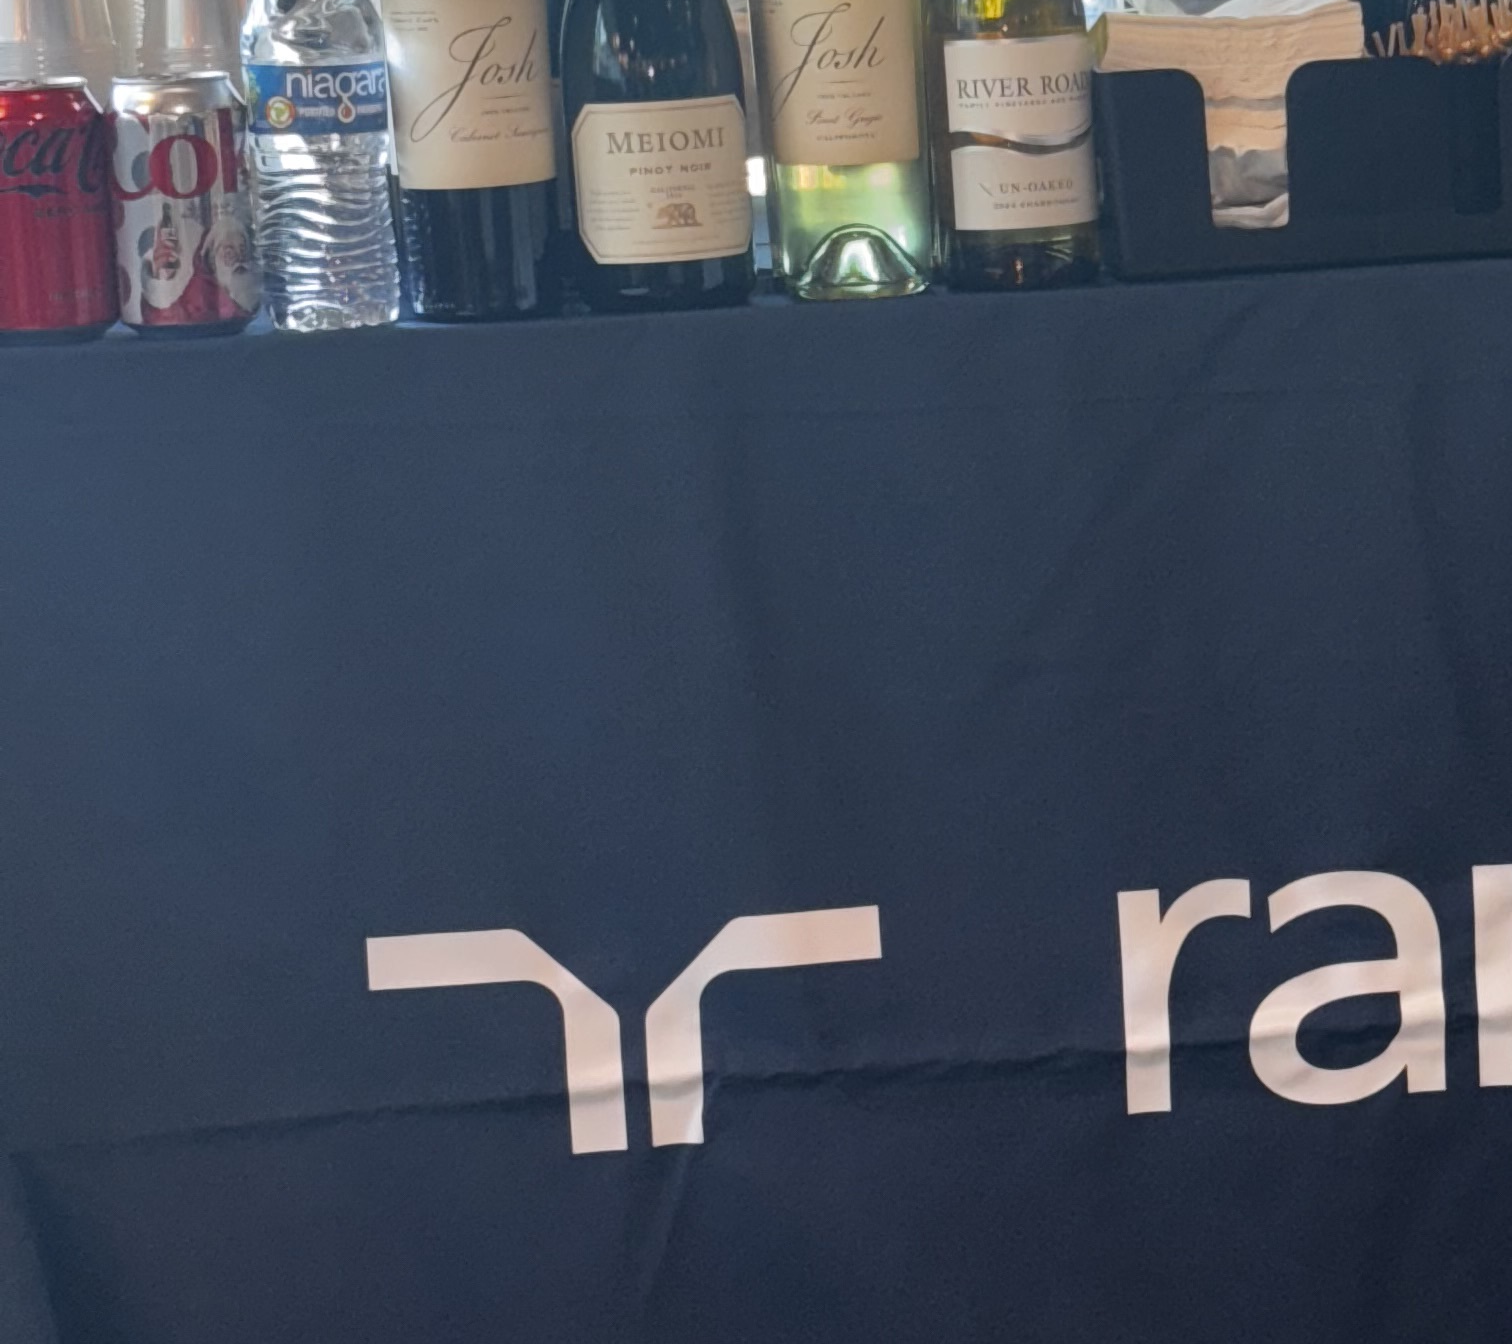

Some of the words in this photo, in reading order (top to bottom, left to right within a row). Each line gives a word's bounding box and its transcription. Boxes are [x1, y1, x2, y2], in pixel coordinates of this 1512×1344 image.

[770, 1, 886, 124] Josh
[411, 15, 537, 143] Josh
[957, 76, 1033, 99] RIVER
[606, 126, 724, 154] MEIOMI
[629, 165, 674, 177] PINOT
[999, 179, 1073, 194] UN-OAKED
